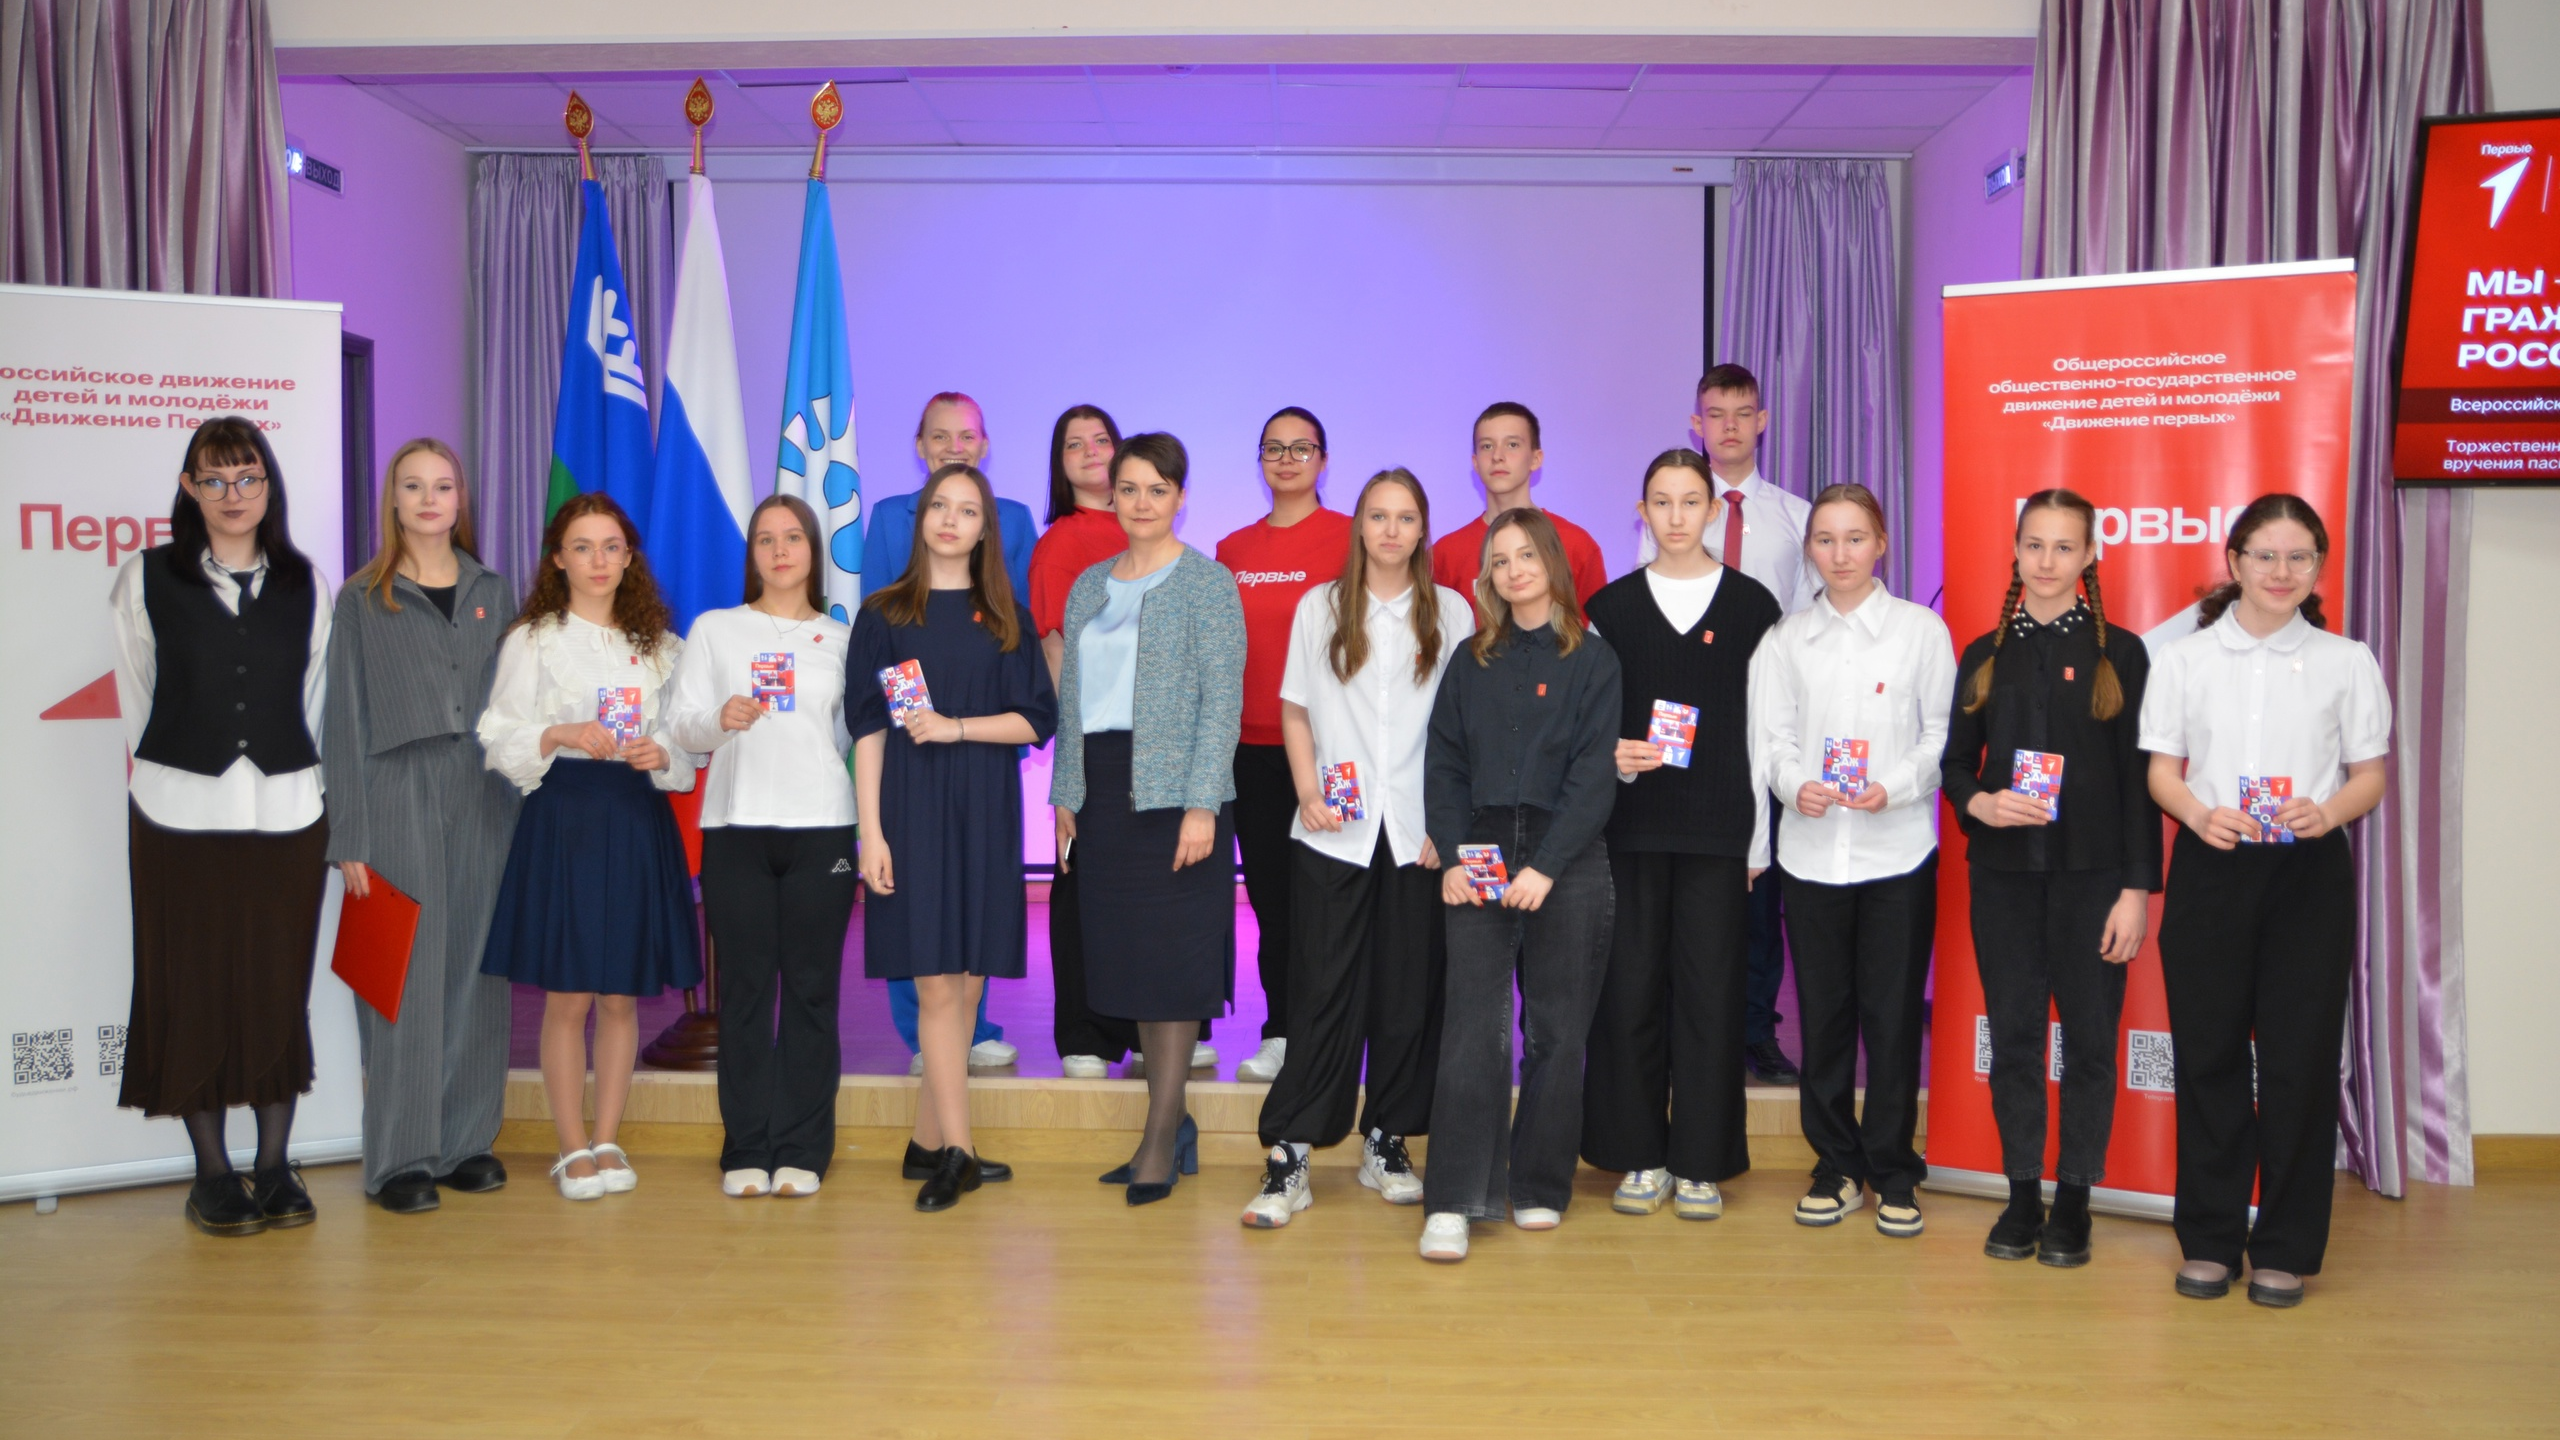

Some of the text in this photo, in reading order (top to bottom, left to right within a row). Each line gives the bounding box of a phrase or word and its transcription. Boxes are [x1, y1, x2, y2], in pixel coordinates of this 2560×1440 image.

[2481, 144, 2533, 158] Первые
[305, 160, 341, 189] ВЫХОД
[2467, 269, 2545, 296] МЫ
[2053, 353, 2227, 372] Общероссийское
[159, 374, 296, 391] движение
[1989, 369, 2297, 394] общественно-государственное
[14, 388, 269, 411] детей и молодёжи
[2003, 388, 2281, 414] движение детей и молодёжи
[0, 407, 161, 428] «Движение
[2042, 412, 2236, 432] «Движение первых»
[2443, 460, 2524, 473] вручения
[1235, 570, 1307, 588] Первые
